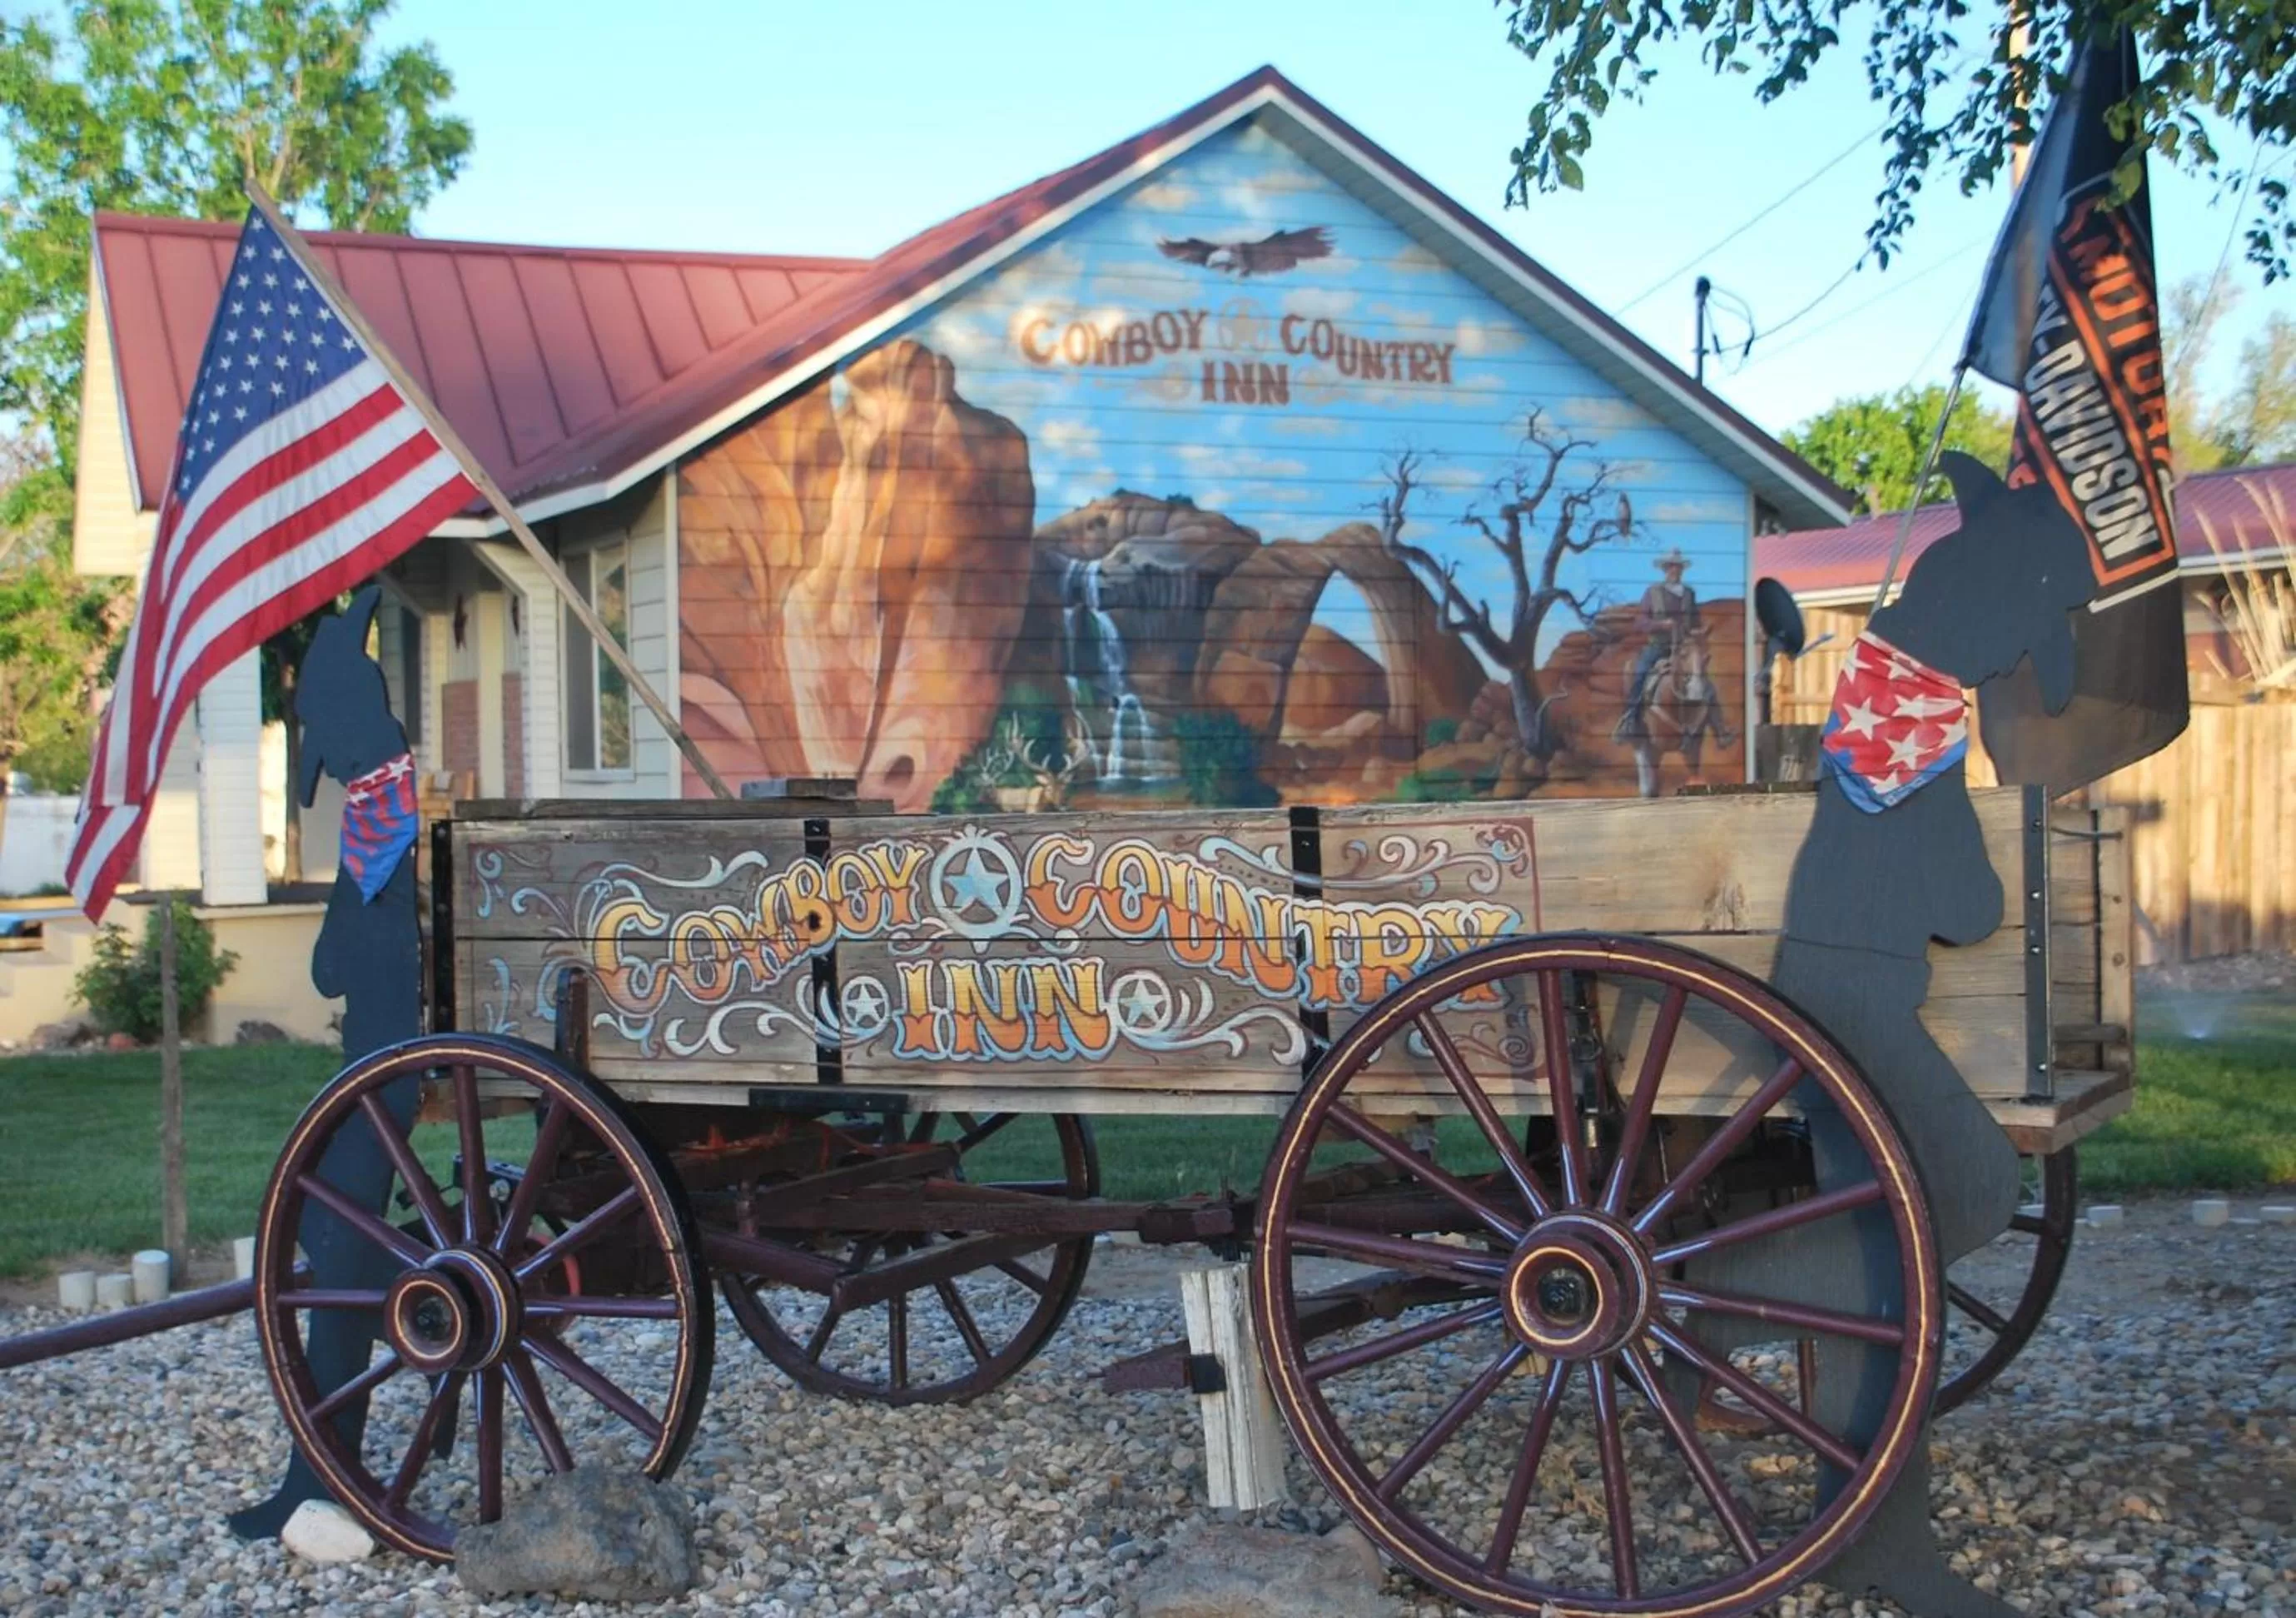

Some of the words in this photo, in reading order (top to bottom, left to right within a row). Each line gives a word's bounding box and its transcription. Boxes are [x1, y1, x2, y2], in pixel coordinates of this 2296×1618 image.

[1018, 308, 1210, 367] COWBOY
[1279, 313, 1456, 384] COUNTRY
[1200, 361, 1290, 406] INN
[2023, 284, 2159, 561] Y-DAVIDSON
[588, 838, 932, 1016] COWBOY
[1025, 834, 1523, 1011] COUNTRY
[892, 958, 1117, 1060] INN
